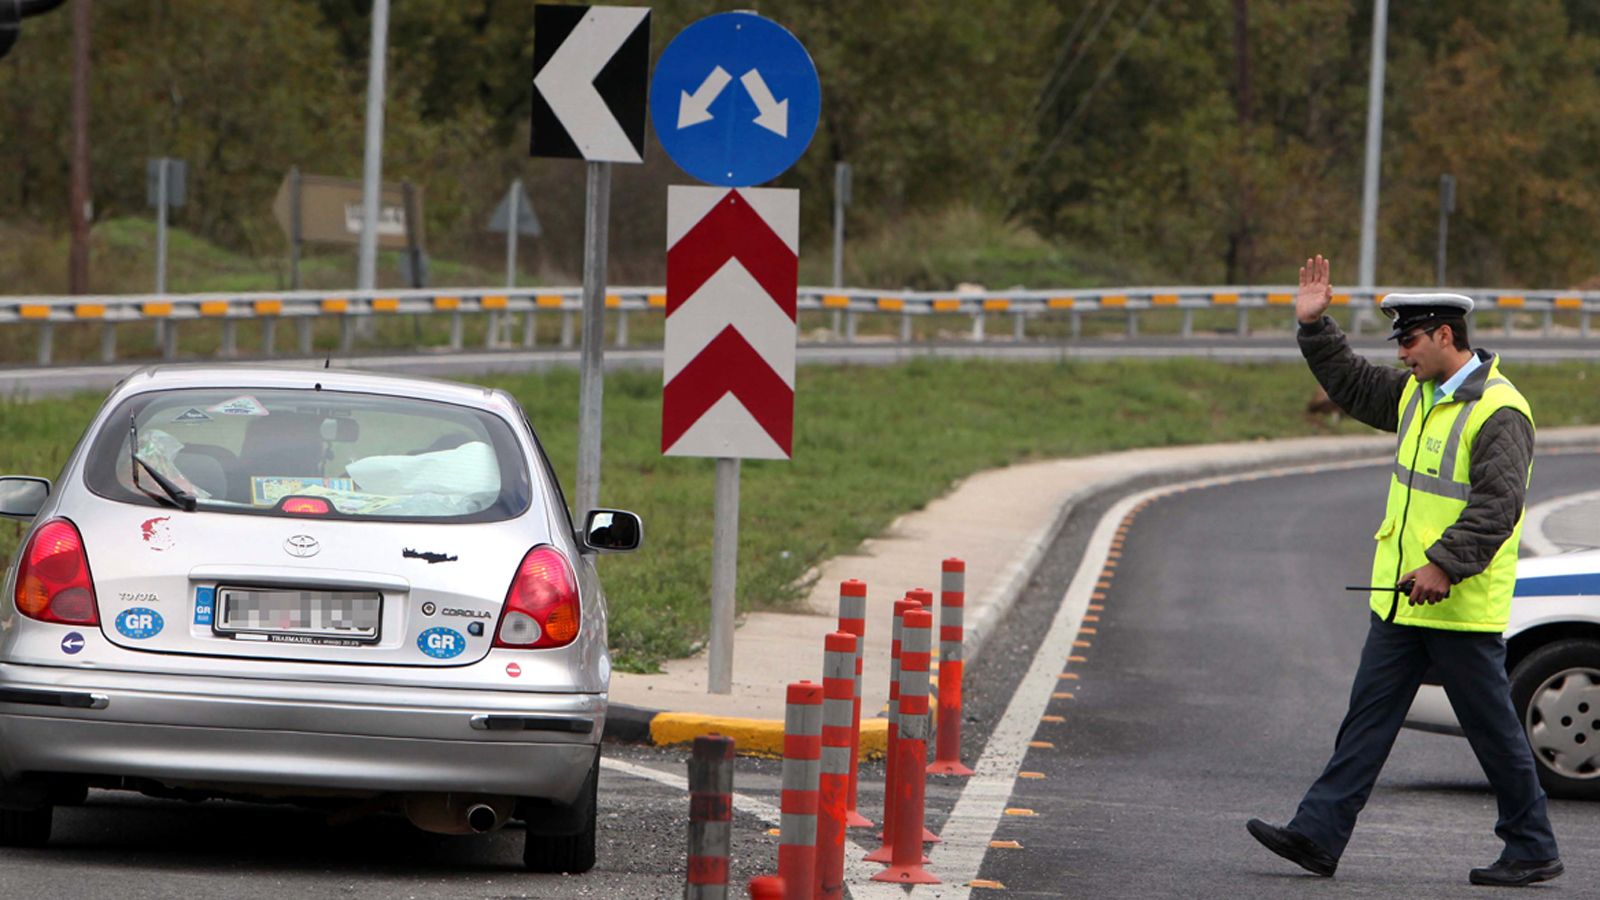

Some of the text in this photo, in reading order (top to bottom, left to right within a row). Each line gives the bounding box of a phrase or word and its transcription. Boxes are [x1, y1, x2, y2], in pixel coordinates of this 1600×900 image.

[1426, 436, 1442, 454] POLICE
[118, 592, 160, 601] TOYOTA
[196, 605, 211, 615] GR
[441, 608, 492, 619] COROLLA
[125, 614, 153, 629] GR
[427, 634, 455, 650] GR
